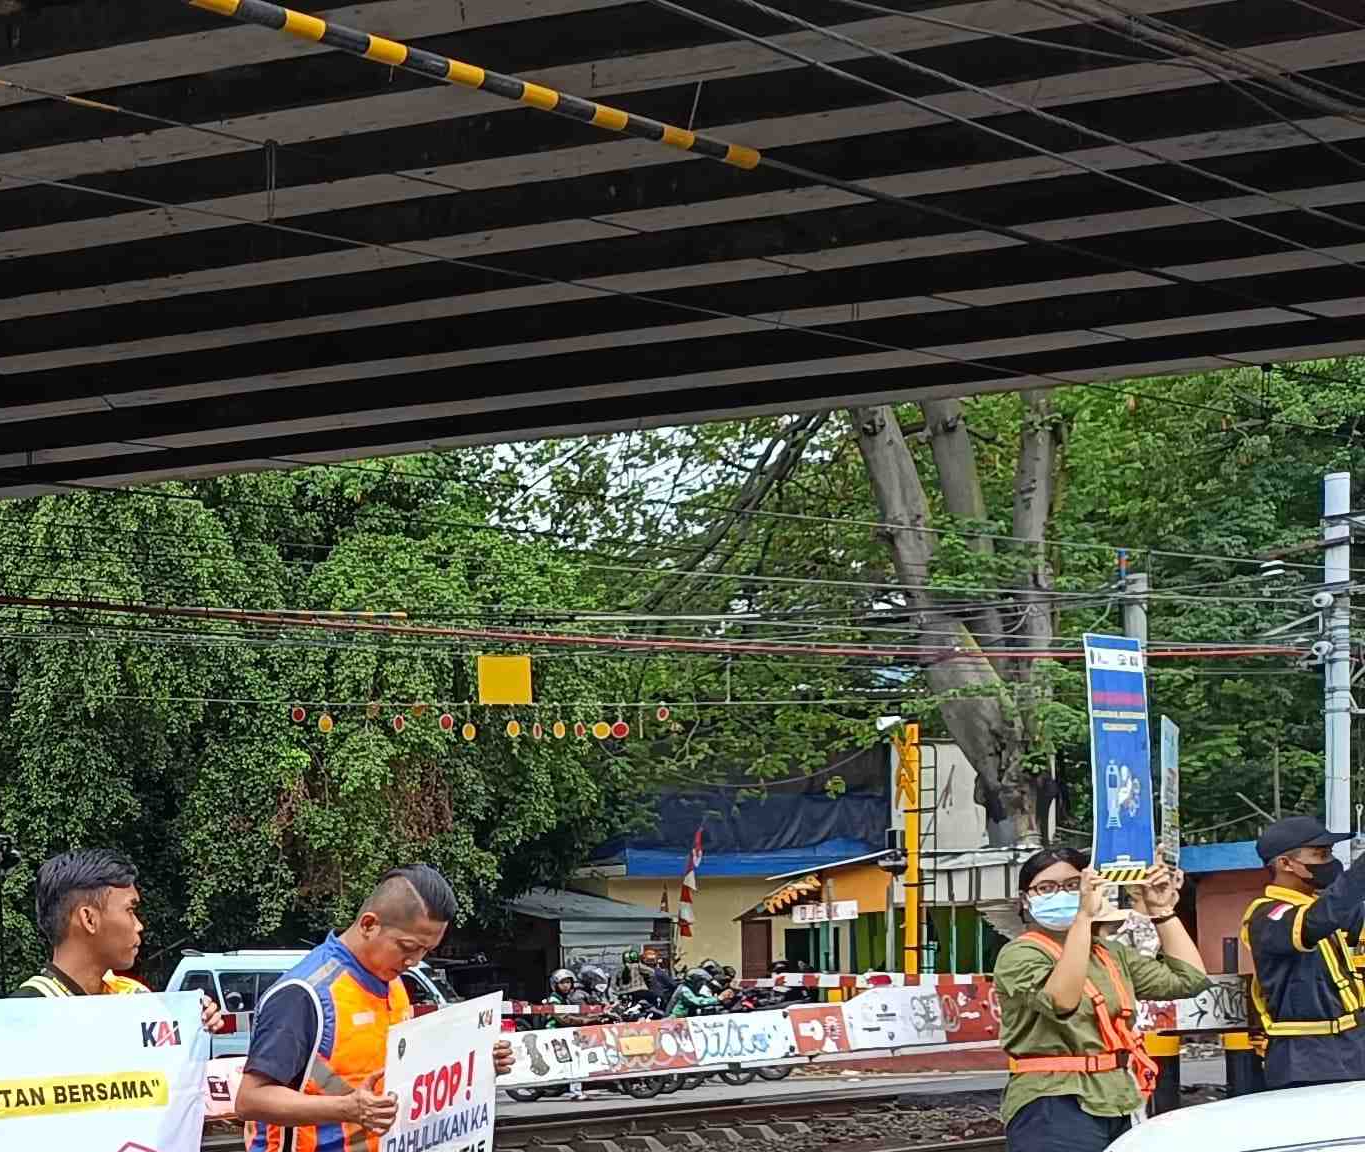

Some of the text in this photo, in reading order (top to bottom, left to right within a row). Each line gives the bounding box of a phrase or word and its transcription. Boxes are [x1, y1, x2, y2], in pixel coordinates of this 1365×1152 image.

[141, 1020, 182, 1048] KAI
[410, 1060, 463, 1121] STOP
[470, 1102, 489, 1132] KA
